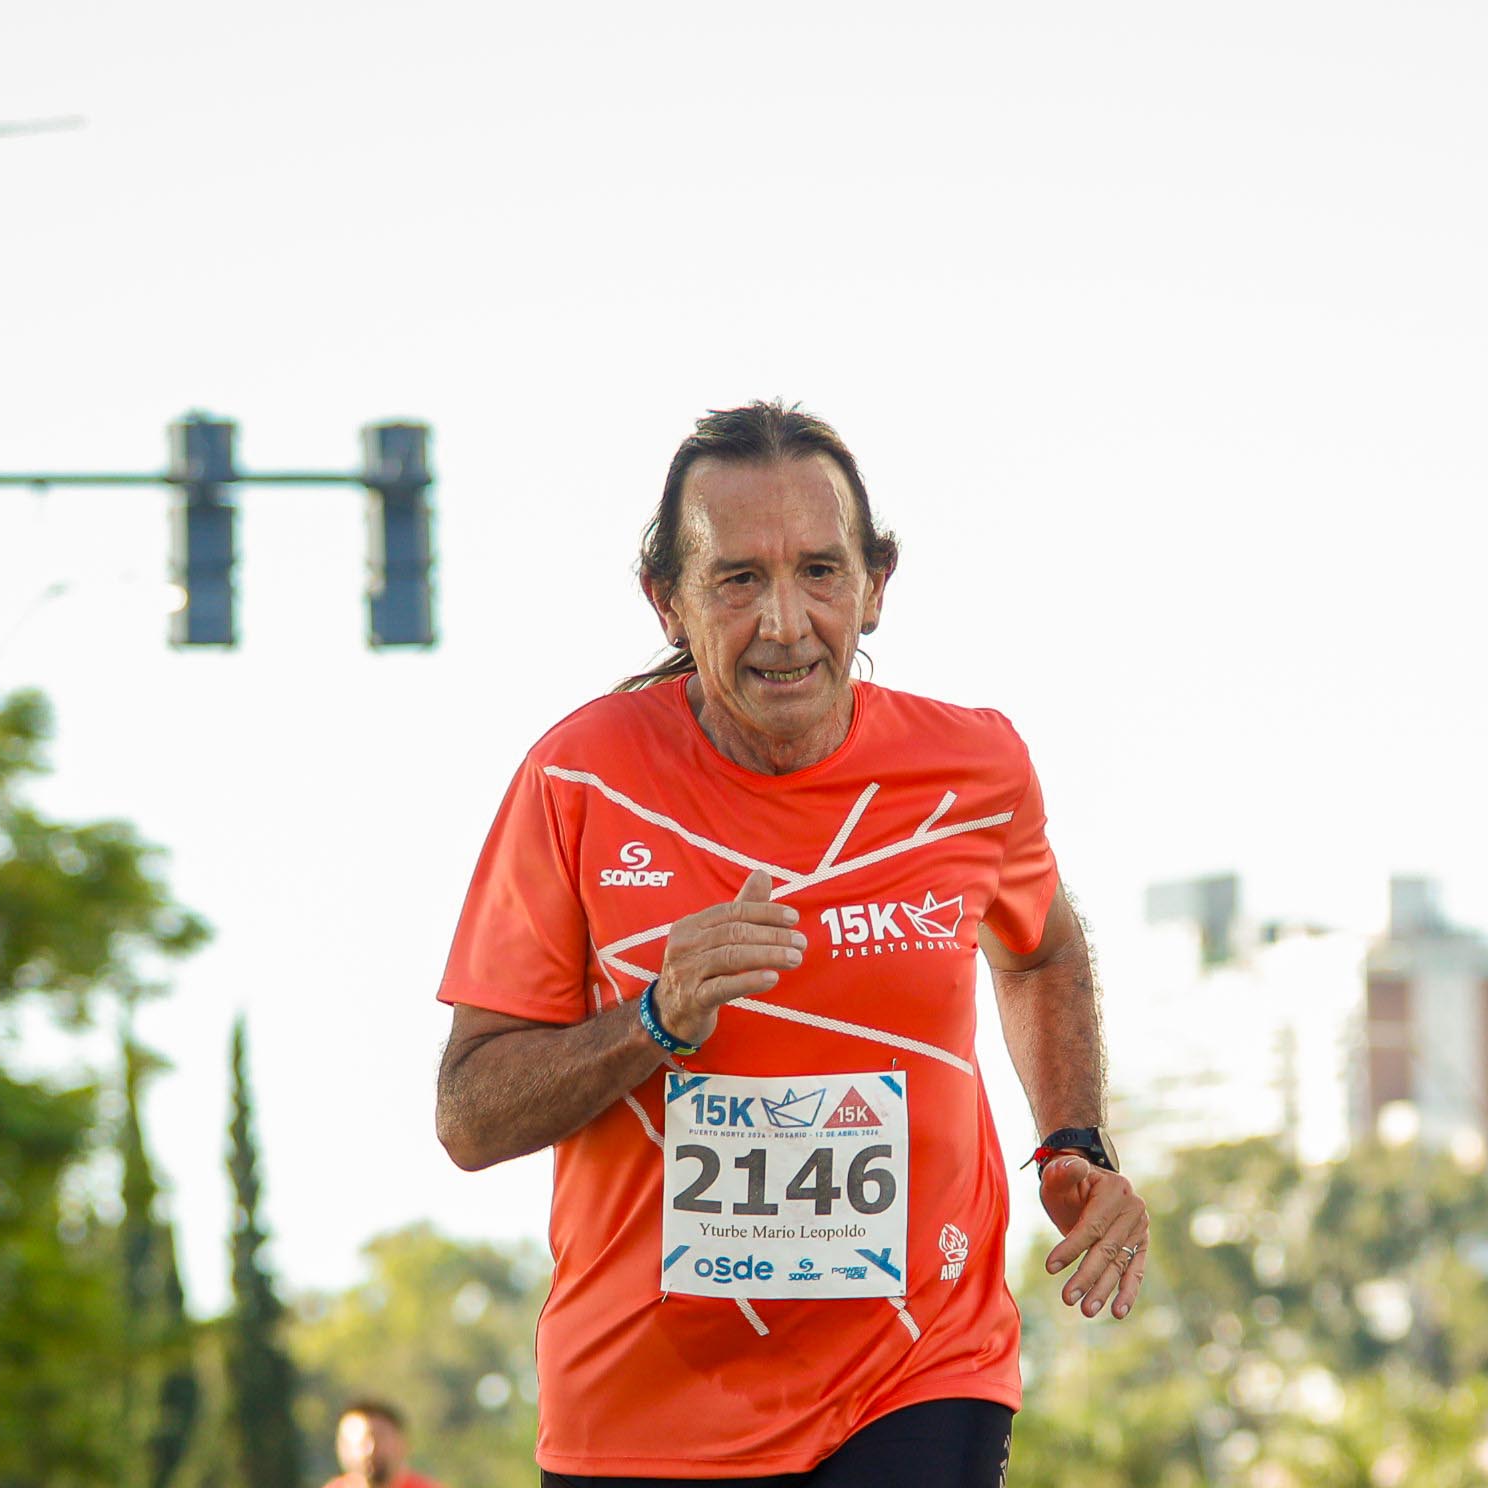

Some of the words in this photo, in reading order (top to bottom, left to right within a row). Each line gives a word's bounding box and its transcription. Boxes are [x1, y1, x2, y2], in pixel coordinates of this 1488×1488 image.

[820, 902, 906, 945] 15K
[832, 942, 908, 959] PUERTO
[915, 940, 961, 950] NORTE
[690, 1093, 756, 1128] 15K
[836, 1105, 871, 1124] 15K
[688, 1128, 718, 1137] PUERTO
[673, 1144, 897, 1216] 2146
[699, 1222, 748, 1239] Yturbe
[752, 1225, 795, 1239] Mario
[799, 1224, 866, 1242] Leopoldo
[694, 1253, 775, 1282] osde
